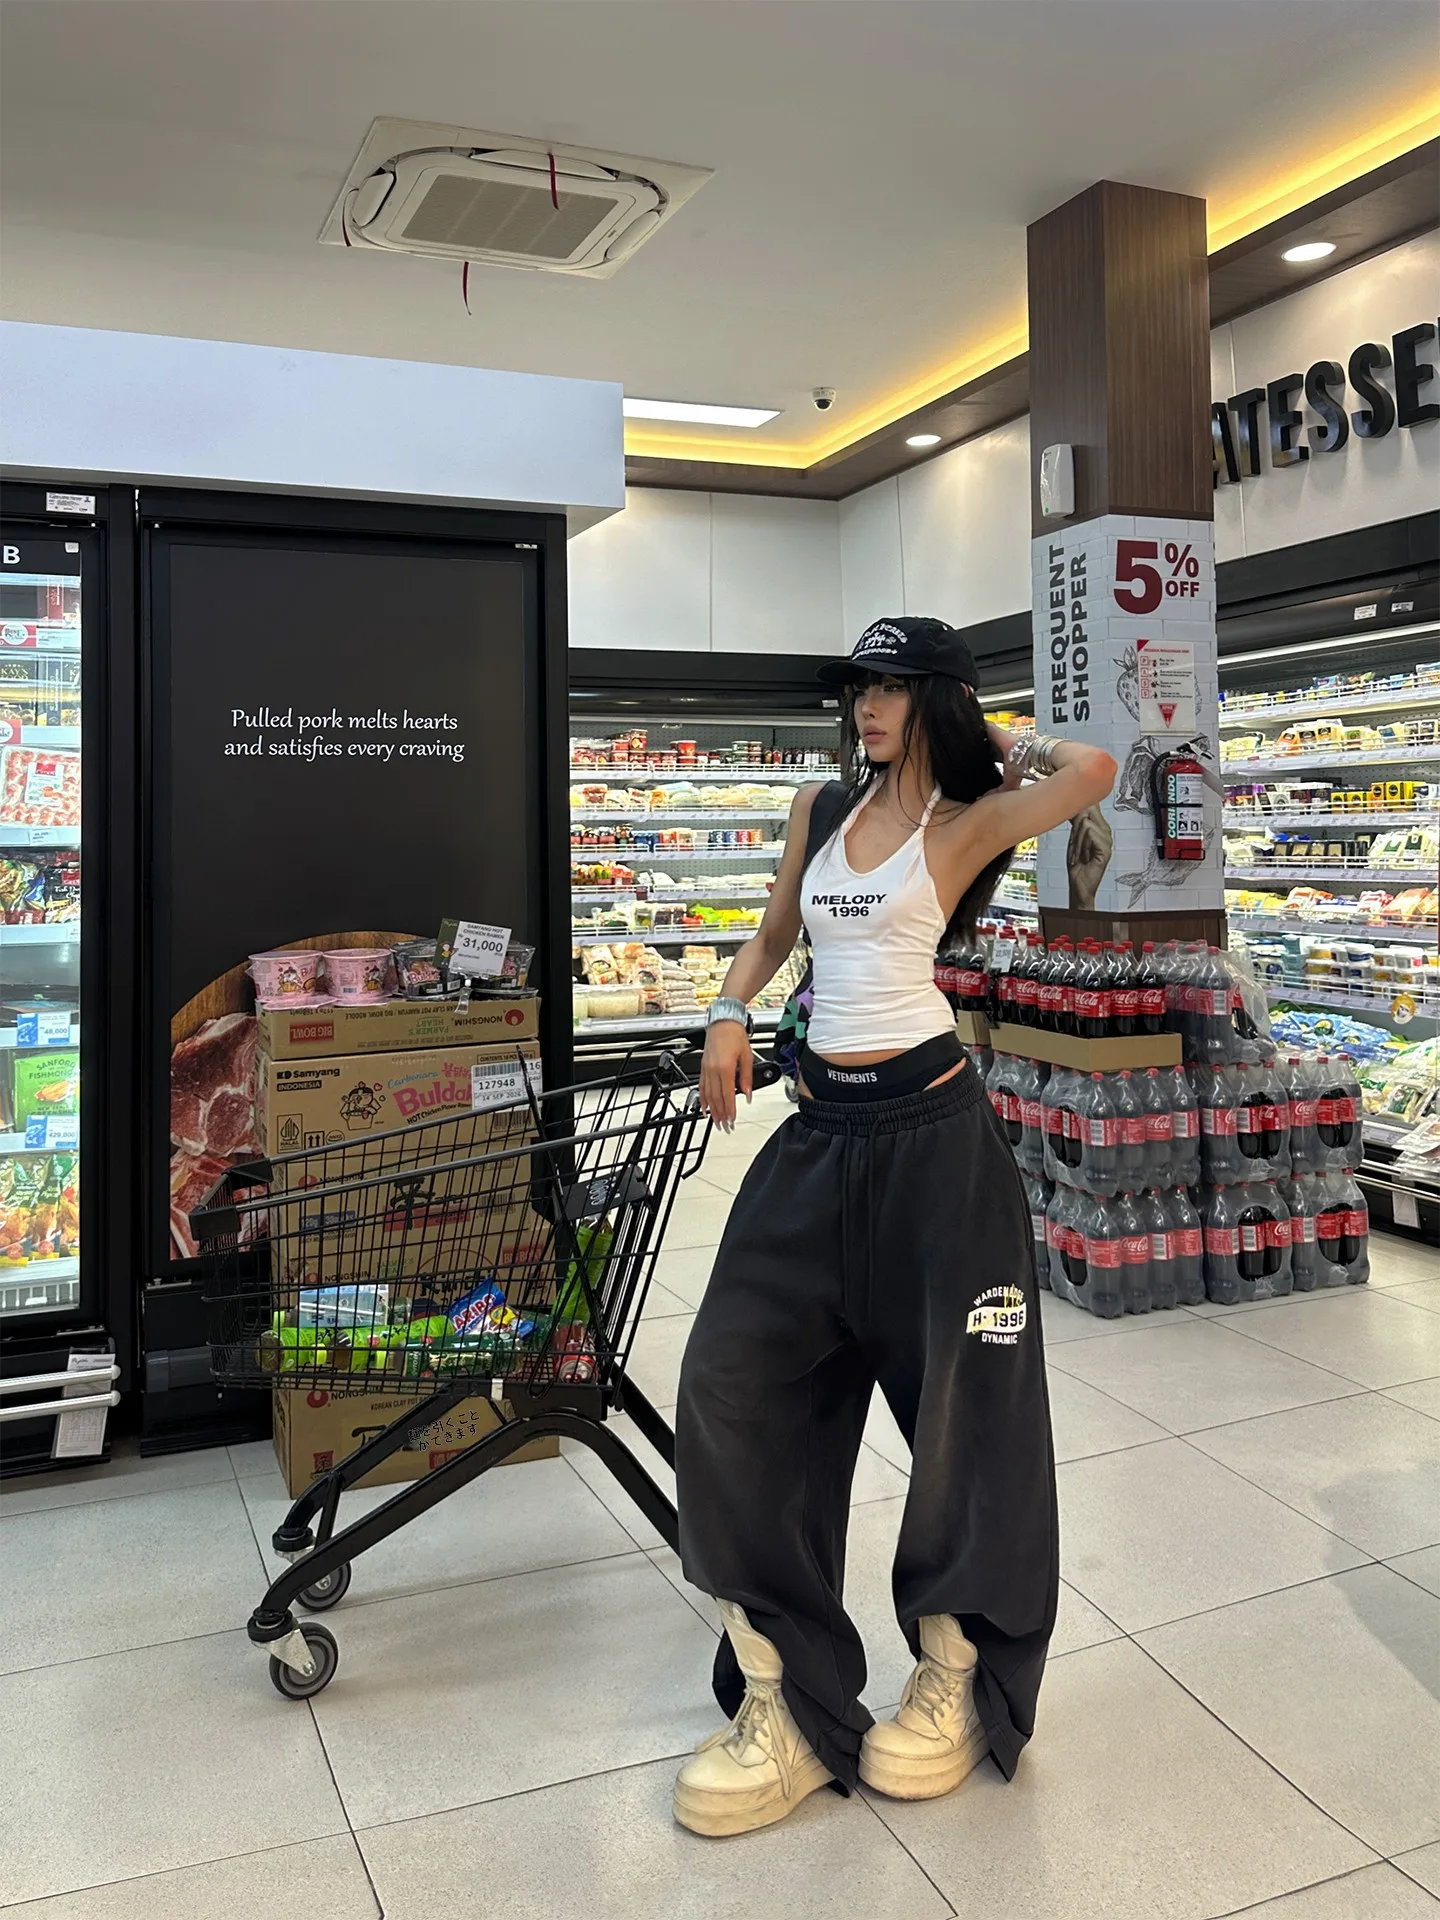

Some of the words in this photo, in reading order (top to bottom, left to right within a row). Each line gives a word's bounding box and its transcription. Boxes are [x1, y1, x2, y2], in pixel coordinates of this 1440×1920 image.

[1211, 317, 1440, 489] ATESSE
[1165, 580, 1200, 598] OFF
[1049, 545, 1070, 724] FREQUENT
[1070, 552, 1090, 722] SHOPPER
[231, 707, 293, 728] Pulled
[298, 708, 344, 734] pork
[348, 709, 398, 729] melts
[403, 709, 458, 730] hearts
[224, 735, 263, 756] and
[268, 735, 343, 762] satisfies
[347, 744, 395, 762] every
[399, 739, 465, 763] craving
[811, 893, 888, 905] MELODY
[828, 906, 870, 917] 1996
[463, 928, 486, 936] CHICKEN
[467, 923, 492, 932] SAMYANG
[463, 937, 503, 953] 31,000
[345, 1012, 367, 1020] NOODLE
[368, 1011, 383, 1019] BOWL
[384, 1010, 393, 1018] BIG
[417, 1018, 444, 1028] HEART
[454, 1015, 503, 1026] NONGSHIM
[290, 1027, 317, 1039] BOWL
[317, 1026, 333, 1037] BIG
[293, 1068, 340, 1079] Samyang
[826, 1068, 878, 1083] VETEMENTS
[278, 1081, 321, 1091] INDONESIA
[479, 1078, 516, 1091] 127948
[406, 1113, 421, 1125] HOT
[993, 1310, 1024, 1328] 1996
[981, 1332, 1018, 1345] DYNAMIC
[370, 1402, 393, 1411] KOREAN
[393, 1399, 407, 1408] CLAY
